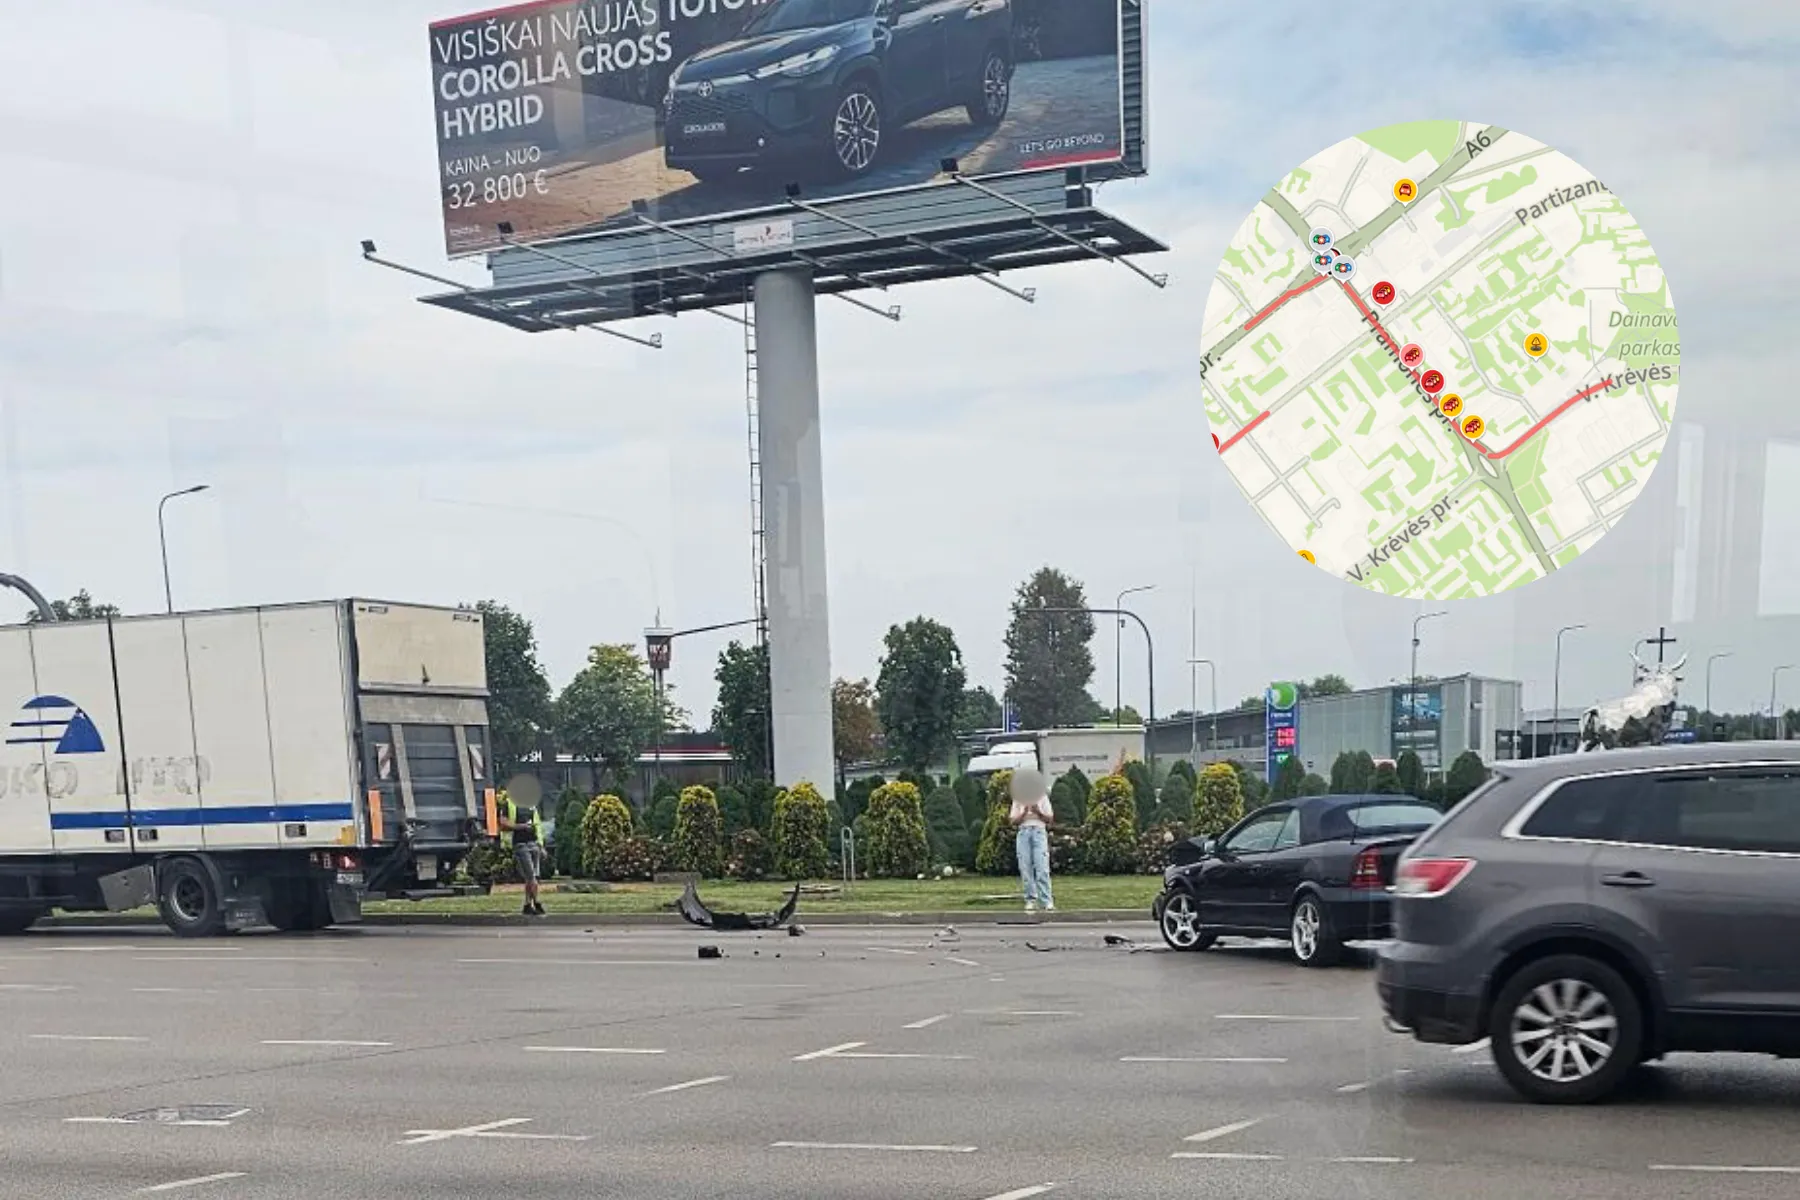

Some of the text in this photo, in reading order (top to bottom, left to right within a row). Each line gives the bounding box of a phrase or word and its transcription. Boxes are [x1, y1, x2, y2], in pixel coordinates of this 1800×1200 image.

[436, 17, 542, 64] VISIŠKAI
[551, 0, 657, 43] NAUJAS
[440, 31, 672, 100] COROLLA CROSS
[443, 94, 543, 139] HYBRID
[445, 155, 490, 176] KAINA
[505, 145, 540, 166] NUO
[1064, 132, 1105, 147] BEYOND
[448, 169, 550, 209] 32 800 €
